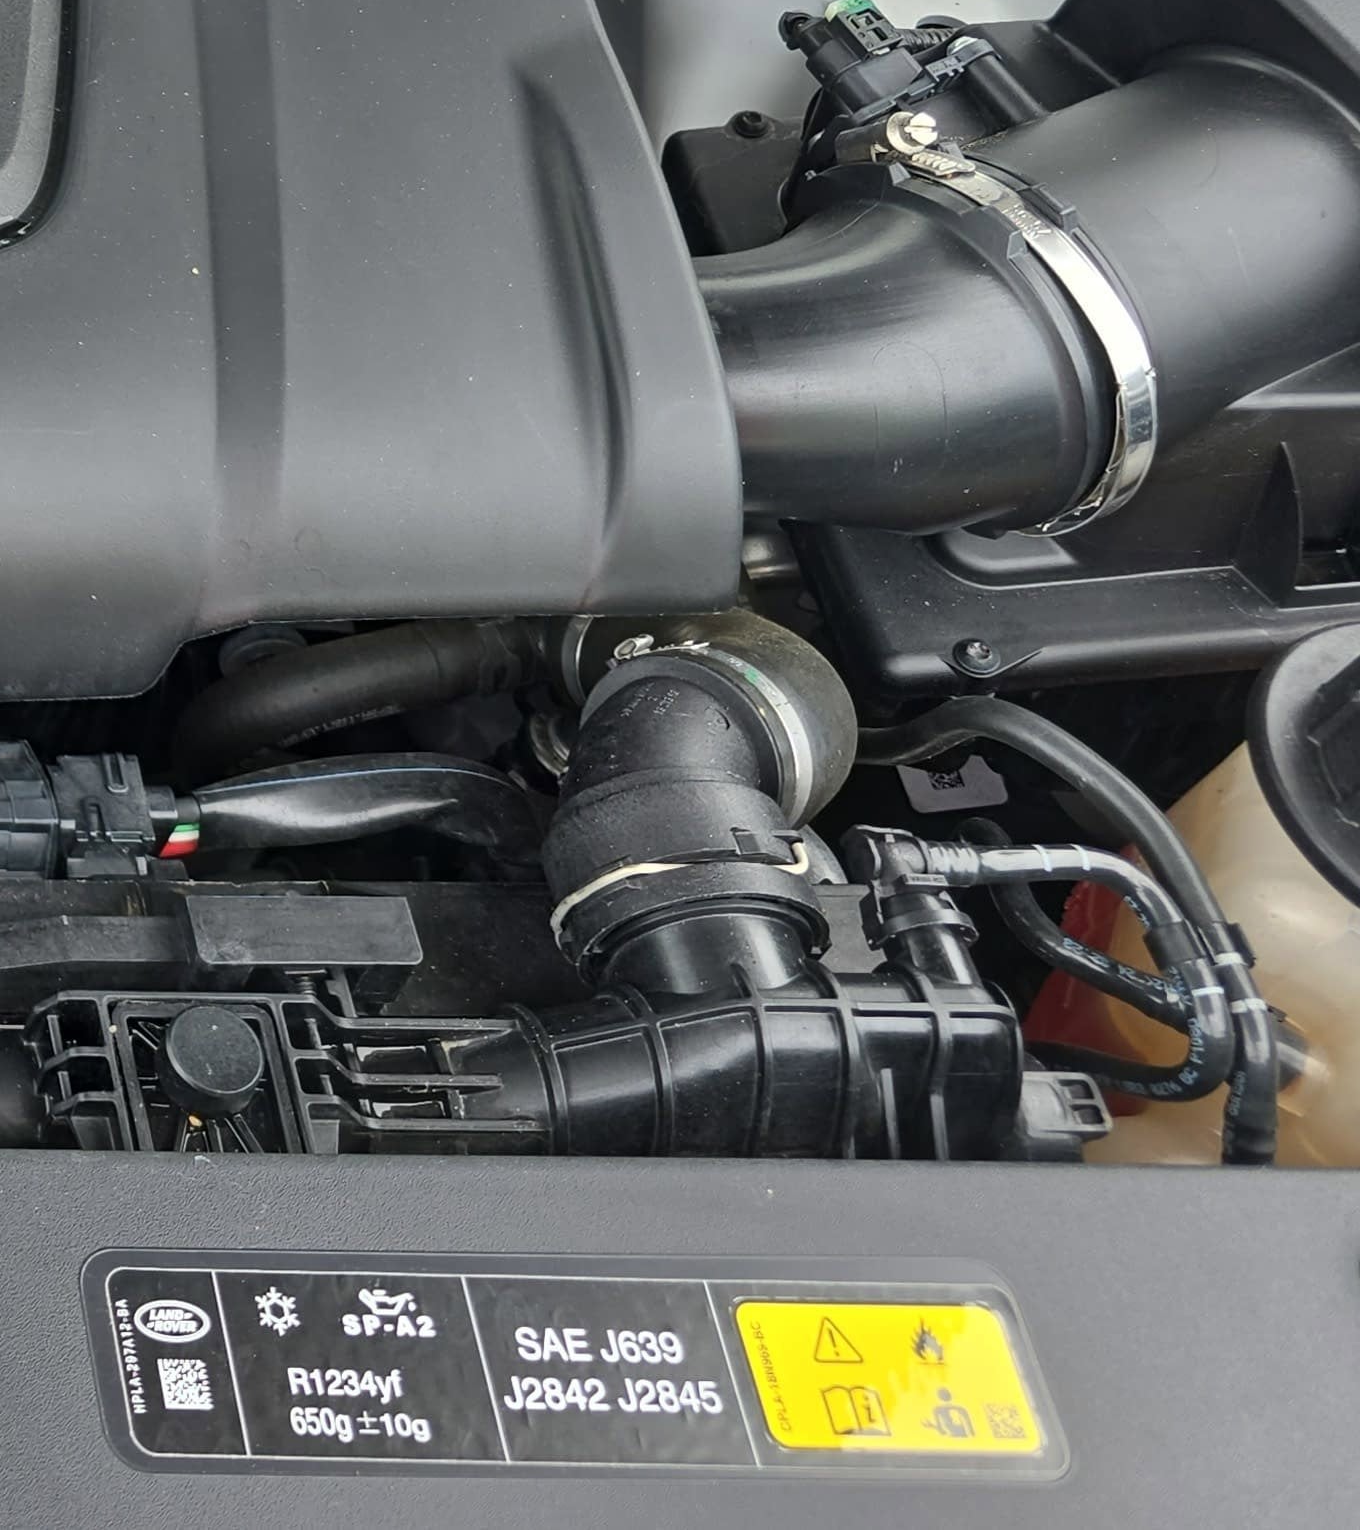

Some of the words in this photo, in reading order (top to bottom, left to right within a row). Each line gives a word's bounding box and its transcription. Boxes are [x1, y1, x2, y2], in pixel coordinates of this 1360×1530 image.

[149, 1309, 184, 1322] LAND
[153, 1320, 198, 1334] ROVER
[342, 1314, 437, 1338] SP-A2
[514, 1326, 593, 1363] SAE
[599, 1328, 685, 1364] J639
[286, 1366, 404, 1404] R1234yf
[503, 1375, 612, 1412] J2842
[616, 1377, 724, 1415] J2845
[289, 1405, 353, 1443] 650g
